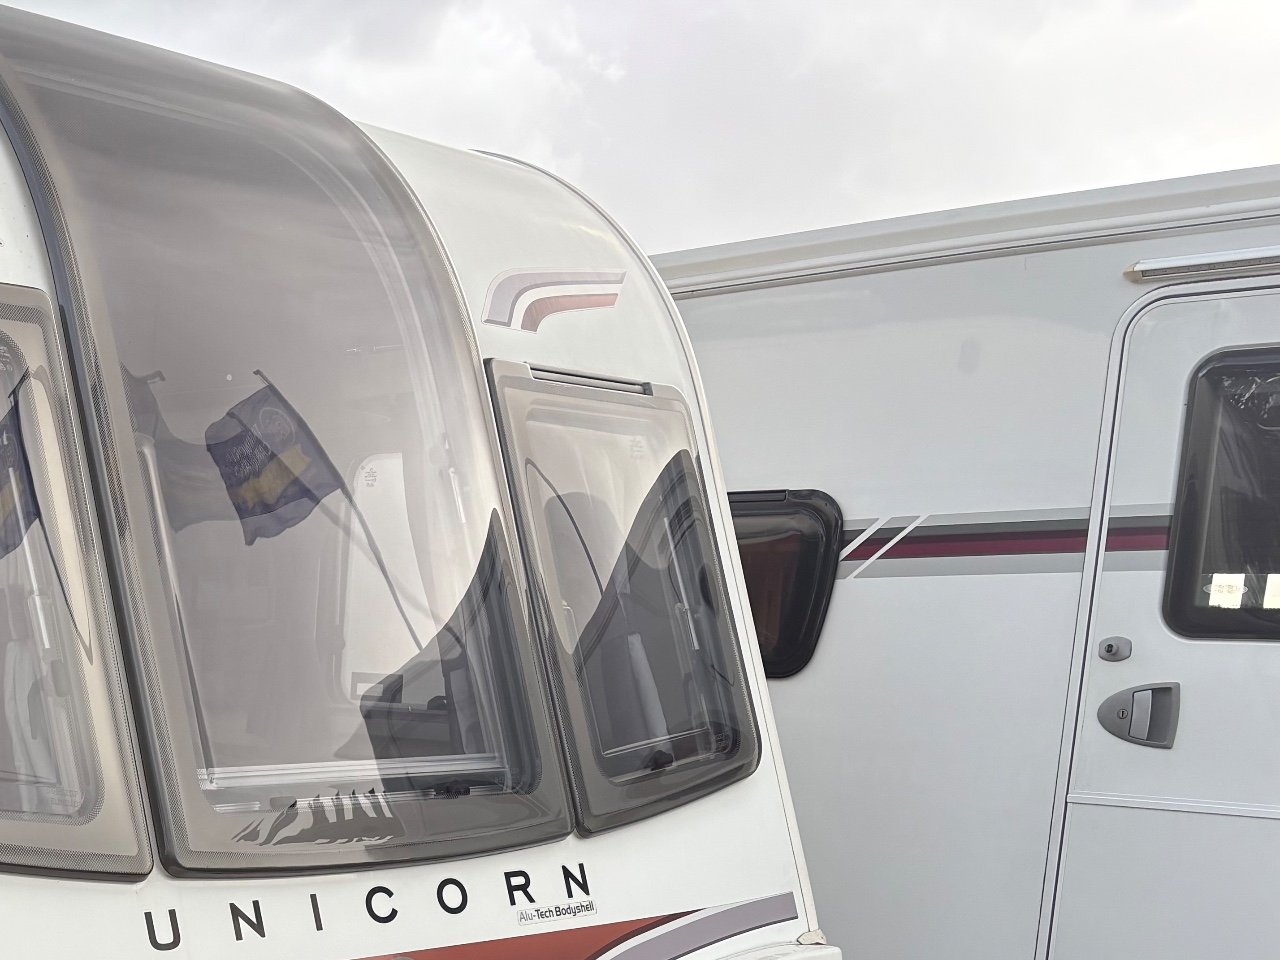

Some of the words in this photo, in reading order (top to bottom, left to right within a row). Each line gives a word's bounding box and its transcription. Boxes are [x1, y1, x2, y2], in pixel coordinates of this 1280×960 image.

[144, 862, 591, 951] UNICORN
[519, 907, 555, 922] Alu-Tech
[554, 901, 595, 917] Bodyshell
